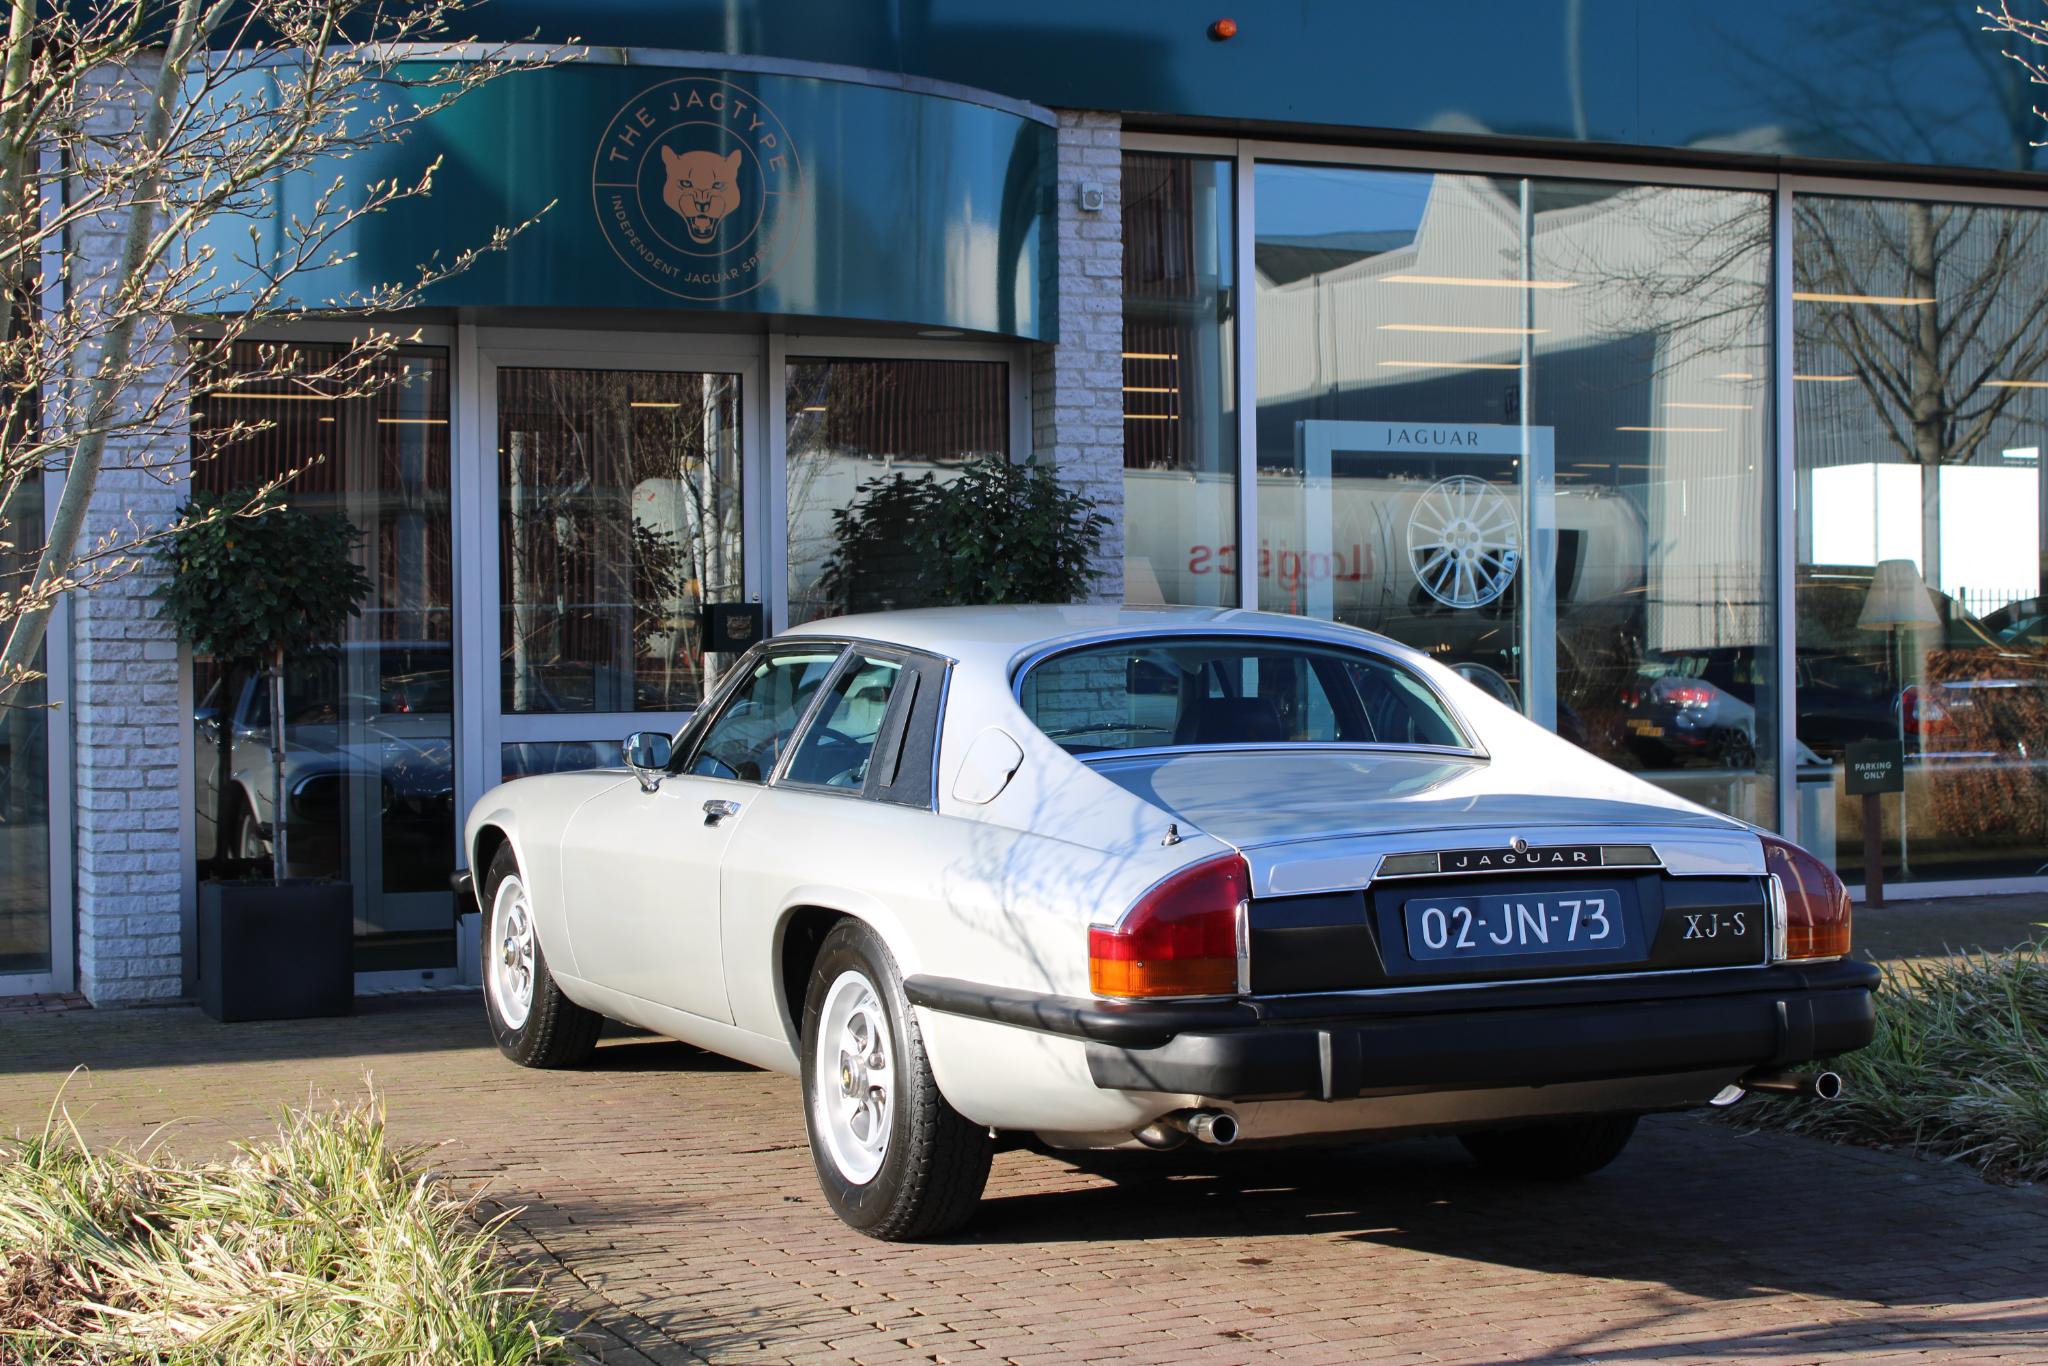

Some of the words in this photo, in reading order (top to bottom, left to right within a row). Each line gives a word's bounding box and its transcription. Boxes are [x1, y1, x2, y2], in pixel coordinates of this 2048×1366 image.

[609, 106, 657, 162] THE
[669, 89, 788, 172] JAGTYPE
[611, 194, 681, 278] INDEPENDENT
[683, 267, 740, 285] JAGUAR
[1386, 428, 1479, 447] JAGUAR
[1854, 761, 1892, 772] PARKING
[1863, 771, 1886, 780] ONLY
[1455, 851, 1589, 868] JAGUAR
[1682, 911, 1747, 941] XJ-S
